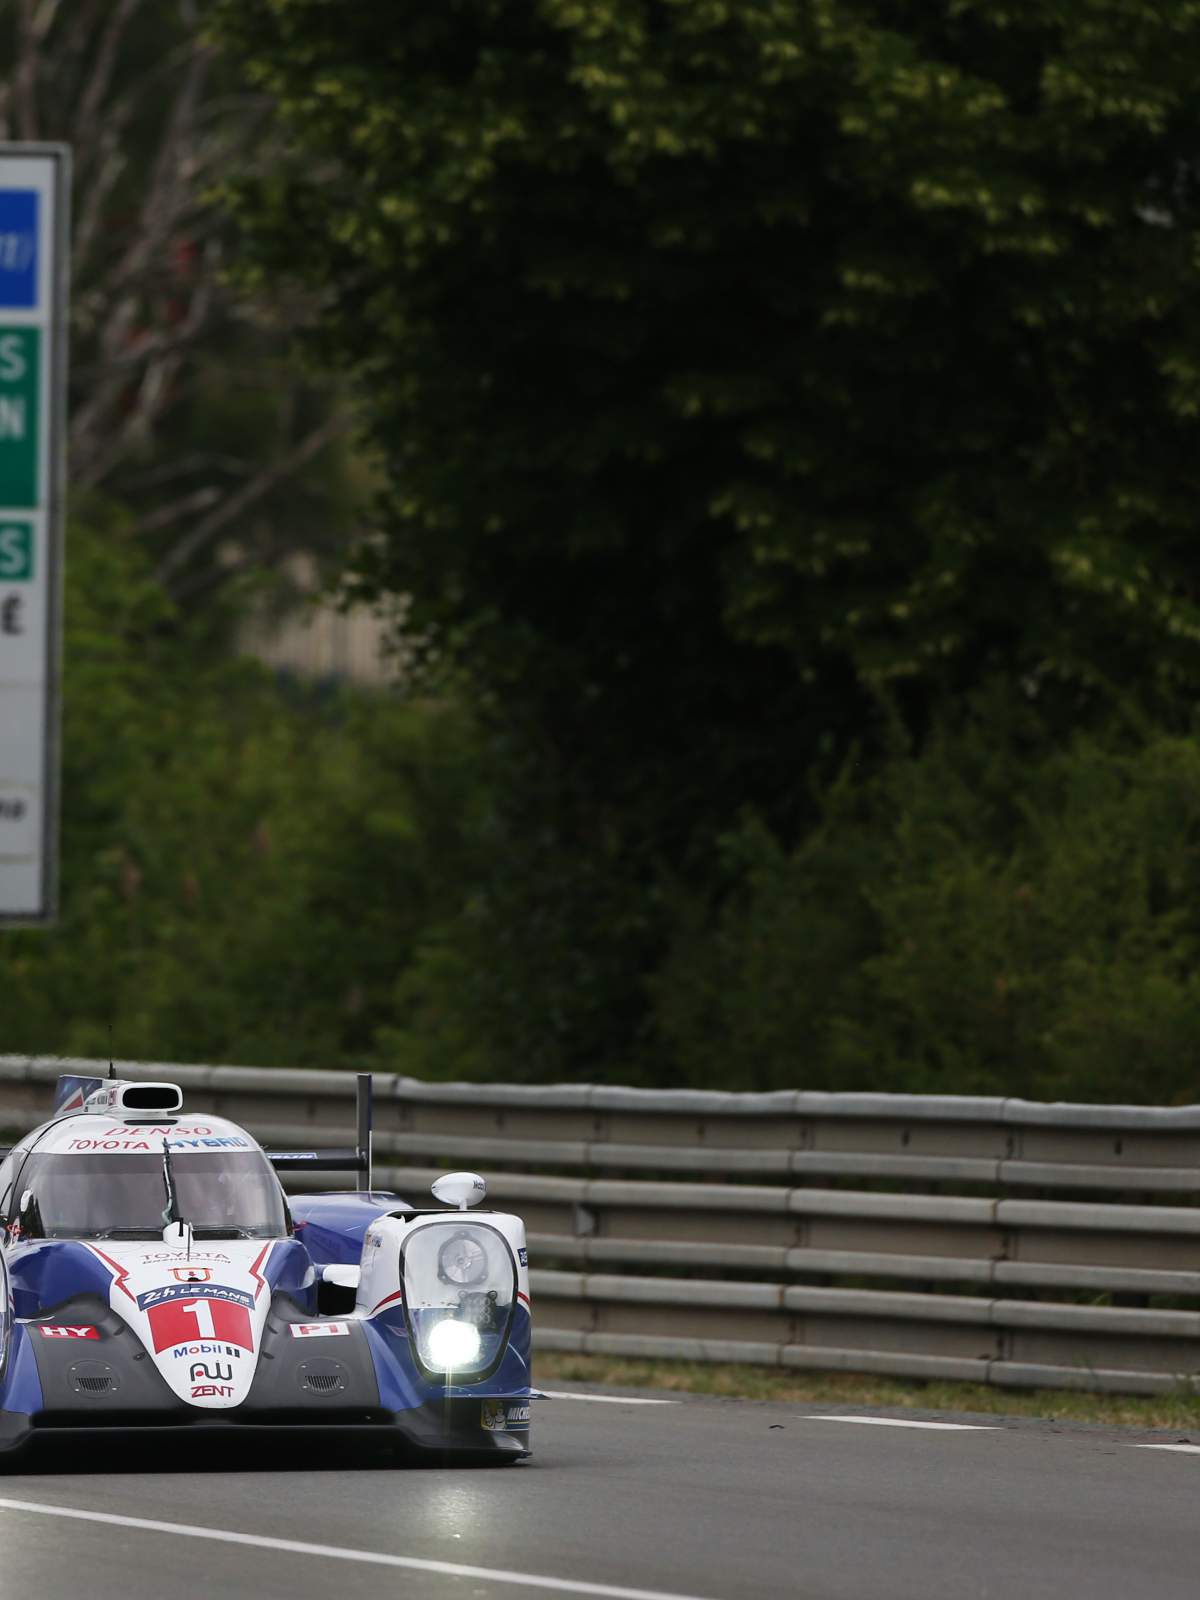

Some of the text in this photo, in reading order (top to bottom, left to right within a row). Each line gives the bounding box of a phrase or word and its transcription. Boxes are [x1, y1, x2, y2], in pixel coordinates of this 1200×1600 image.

[103, 1126, 213, 1137] DENSO
[68, 1137, 250, 1150] TOYOTA HYBRID
[140, 1252, 230, 1260] TOYOTA
[180, 1287, 201, 1295] LE
[203, 1288, 251, 1303] MANS
[183, 1299, 217, 1339] 1
[40, 1326, 92, 1337] HY
[298, 1324, 339, 1335] P1
[173, 1344, 222, 1359] Mobil
[191, 1385, 235, 1399] ZENT
